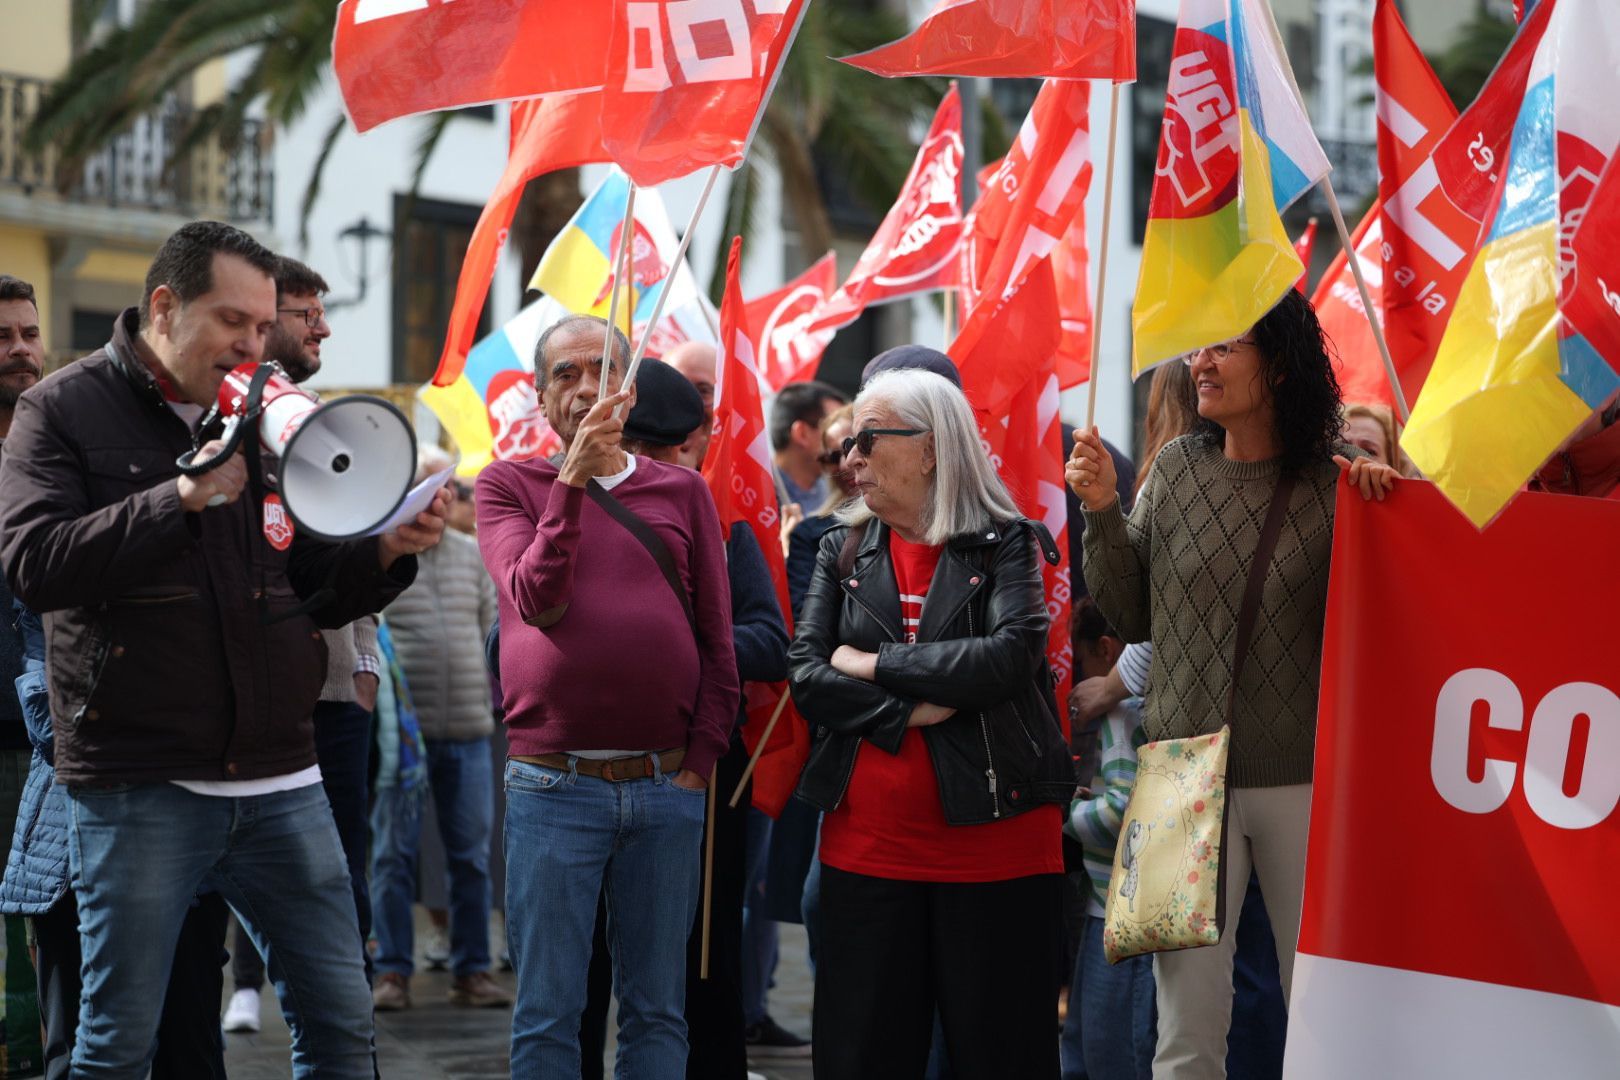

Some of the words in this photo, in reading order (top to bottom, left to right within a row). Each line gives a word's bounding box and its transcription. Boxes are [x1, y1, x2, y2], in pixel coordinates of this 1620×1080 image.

[1167, 50, 1239, 163] UGT
[1416, 280, 1448, 316] la
[264, 502, 286, 527] UGT
[1430, 667, 1620, 829] CO
